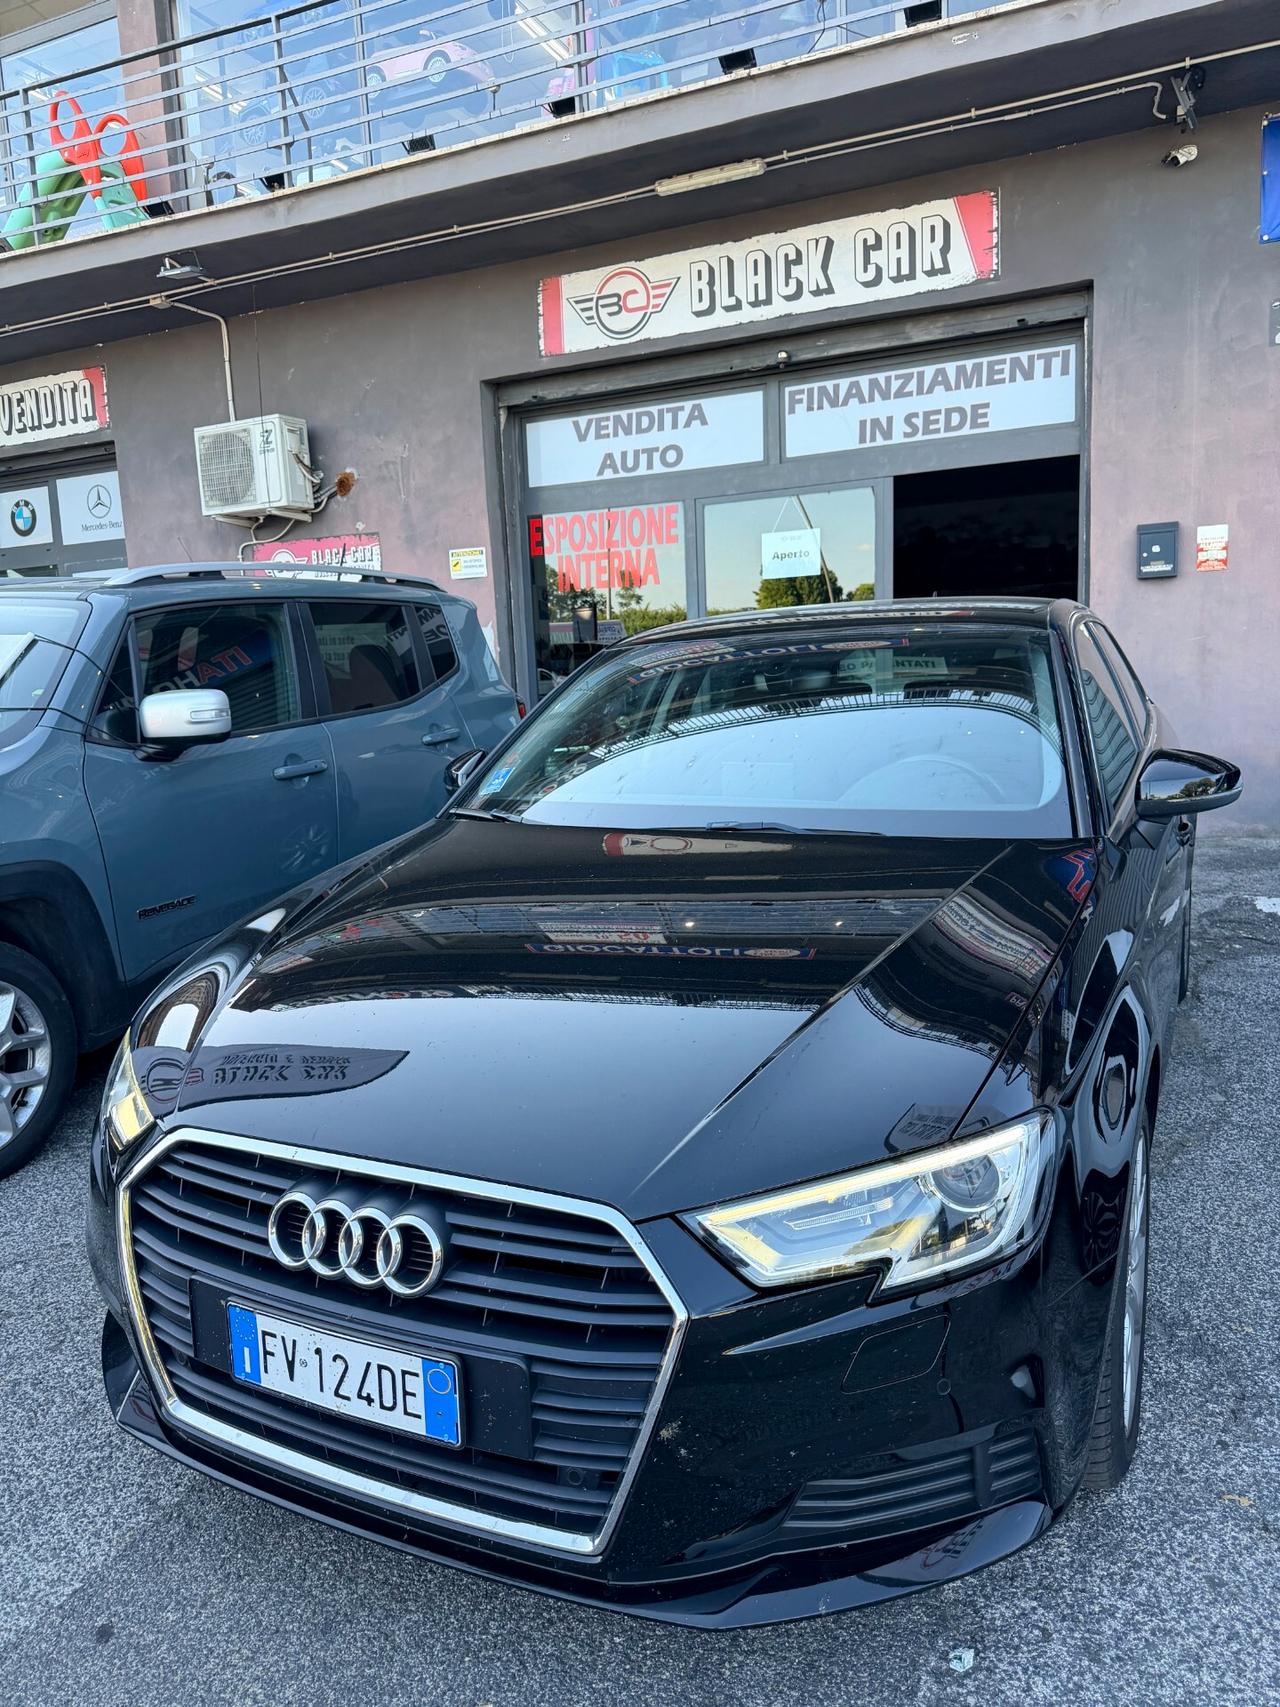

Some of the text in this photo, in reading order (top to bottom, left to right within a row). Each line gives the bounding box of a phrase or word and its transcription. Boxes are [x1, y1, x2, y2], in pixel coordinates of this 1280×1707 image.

[689, 214, 951, 318] BLACK CAR
[787, 349, 1071, 415] FINANZIAMENTI
[0, 378, 96, 436] VENDITA
[572, 403, 708, 442] VENDITA
[858, 402, 990, 444] IN SEDE
[596, 444, 684, 477] AUTO
[529, 504, 679, 557] ESPOSIZIONE
[772, 549, 809, 561] Aperto
[557, 547, 660, 593] INTERNA
[260, 1329, 422, 1420] FV 124DE
